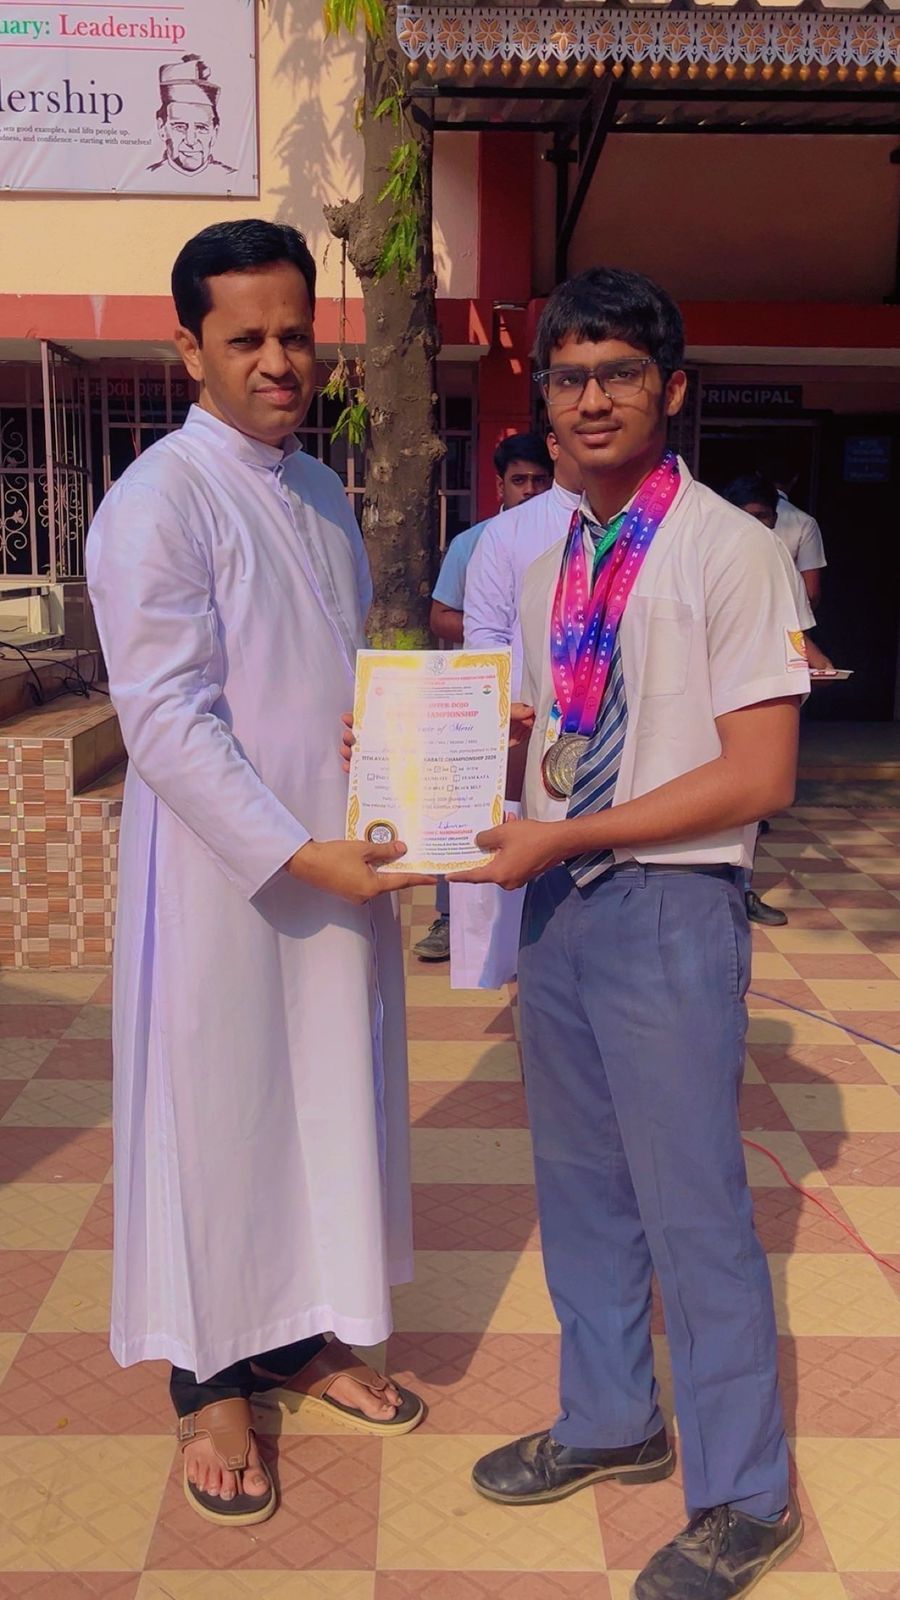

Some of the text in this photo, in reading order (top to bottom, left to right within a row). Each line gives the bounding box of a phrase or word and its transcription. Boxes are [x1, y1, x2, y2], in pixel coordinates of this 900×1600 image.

[59, 13, 186, 44] Leadership
[16, 125, 33, 133] good
[34, 126, 67, 134] examples,
[95, 128, 118, 136] people
[36, 135, 72, 143] confidence
[120, 138, 152, 146] ourselves!
